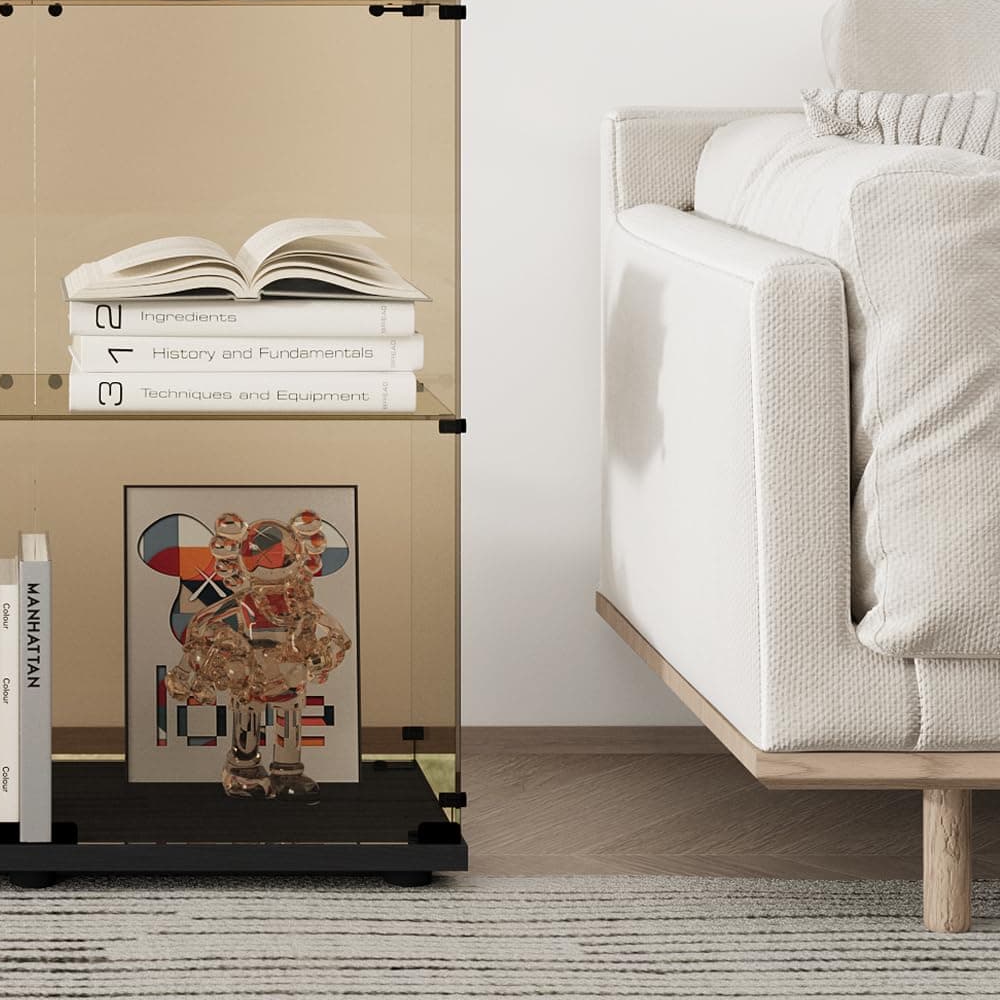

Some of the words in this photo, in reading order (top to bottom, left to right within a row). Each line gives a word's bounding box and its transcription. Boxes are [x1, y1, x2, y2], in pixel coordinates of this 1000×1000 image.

[95, 303, 122, 330] 2
[140, 311, 238, 324] Ingredients
[107, 347, 134, 364] 1
[152, 347, 216, 362] History
[222, 347, 253, 359] and
[259, 346, 375, 359] Fundamentals
[98, 381, 123, 406] 3
[140, 387, 233, 402] Techniques
[239, 388, 270, 400] and
[276, 389, 371, 403] Equipment
[2, 602, 11, 630] Colour
[27, 583, 41, 689] MANHATTAN
[2, 677, 11, 705] Colour
[2, 766, 11, 793] Colour
